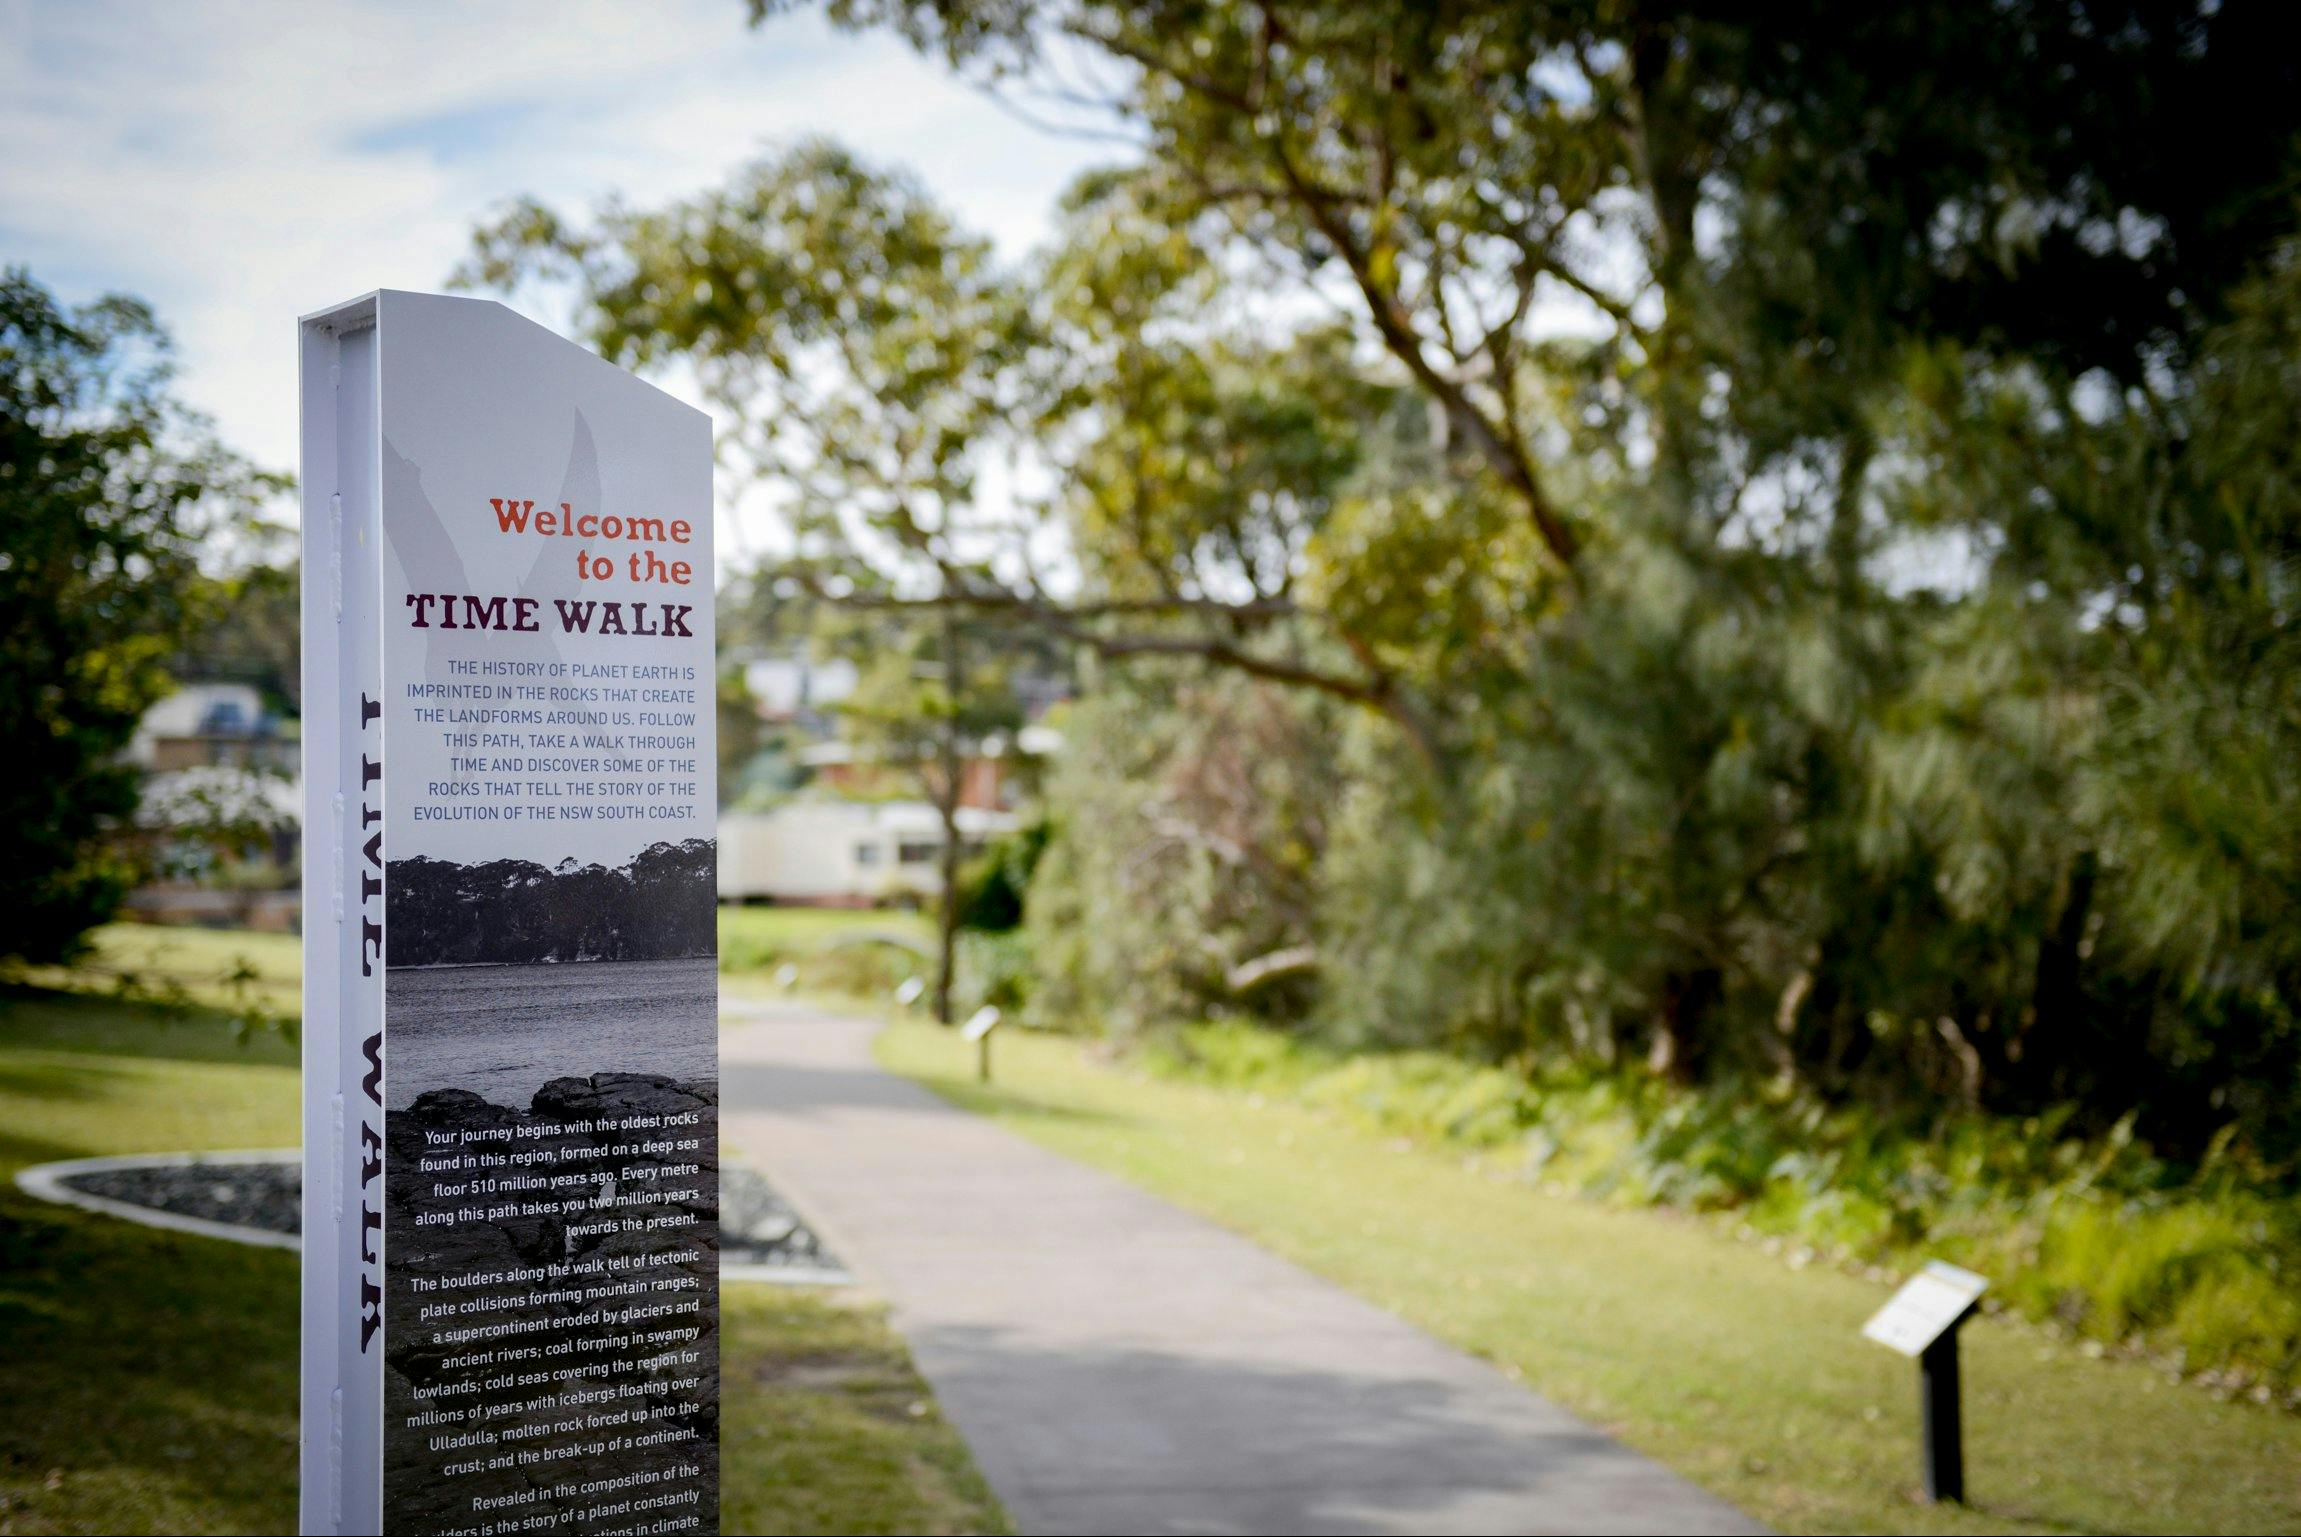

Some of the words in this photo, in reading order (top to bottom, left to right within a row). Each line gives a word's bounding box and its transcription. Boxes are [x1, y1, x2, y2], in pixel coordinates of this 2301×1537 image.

[489, 498, 692, 544] Welcome
[577, 549, 614, 581] to
[628, 549, 692, 585] the
[405, 594, 540, 632] TIME
[554, 599, 693, 637] WALK
[447, 659, 478, 675] THE
[482, 660, 545, 677] HISTORY
[548, 662, 567, 677] OF
[572, 663, 628, 678] PLANET
[632, 665, 678, 679] EARTH
[682, 666, 695, 680] IS
[407, 683, 492, 699] IMPRINTED
[497, 685, 512, 699] IN
[516, 685, 545, 700] THE
[550, 686, 598, 701] ROCKS
[602, 688, 638, 702] THAT
[642, 689, 695, 703] CREATE
[413, 708, 445, 723] THE
[449, 708, 543, 724] LANDFORMS
[546, 710, 608, 725] AROUND
[612, 712, 635, 725] US.
[639, 712, 695, 726] FOLLOW
[442, 732, 478, 747] THIS
[482, 733, 524, 750] PATH,
[528, 734, 566, 748] TAKE
[569, 735, 579, 748] A
[582, 735, 624, 749] WALK
[627, 735, 695, 749] THROUGH
[450, 757, 487, 772] TIME
[490, 757, 523, 772] AND
[527, 758, 599, 772] DISCOVER
[603, 758, 643, 772] SOME
[647, 759, 665, 772] OF
[668, 759, 696, 772] THE
[428, 781, 480, 796] ROCKS
[483, 781, 522, 796] THAT
[525, 782, 562, 796] TELL
[565, 782, 594, 796] THE
[598, 782, 643, 796] STORY
[647, 782, 665, 796] OF
[668, 782, 696, 796] THE
[413, 806, 499, 821] EVOLUTION
[503, 806, 523, 820] OF
[526, 805, 555, 820] THE
[560, 805, 594, 820] NSW
[597, 805, 644, 819] SOUTH
[648, 805, 696, 819] COAST.
[425, 1130, 457, 1145] Your
[461, 1128, 513, 1145] journey
[516, 1122, 561, 1140] begins
[563, 1119, 592, 1134] with
[596, 1117, 617, 1131] the
[620, 1114, 661, 1129] oldest
[662, 1111, 699, 1128] rocks
[419, 1155, 460, 1172] found
[464, 1154, 476, 1168] in
[480, 1152, 506, 1167] this
[509, 1148, 557, 1166] region,
[560, 1143, 608, 1160] formed
[611, 1144, 628, 1156] on
[631, 1143, 639, 1154] a
[642, 1139, 674, 1155] deep
[676, 1138, 699, 1150] sea
[433, 1183, 467, 1197] floor
[471, 1178, 496, 1194] 510
[499, 1175, 547, 1191] million
[550, 1173, 587, 1190] years
[590, 1171, 618, 1187] ago.
[621, 1166, 658, 1181] Every
[660, 1163, 699, 1177] metre
[415, 1211, 454, 1226] along
[457, 1206, 485, 1222] this
[488, 1203, 518, 1220] path
[522, 1202, 559, 1215] takes
[562, 1199, 585, 1213] you
[588, 1197, 610, 1210] two
[615, 1190, 662, 1207] million
[663, 1188, 700, 1205] years
[565, 1219, 619, 1237] towards
[621, 1217, 643, 1231] the
[646, 1212, 699, 1232] present.
[410, 1277, 437, 1292] The
[441, 1271, 503, 1289] boulders
[506, 1267, 545, 1282] along
[547, 1259, 570, 1277] the
[572, 1258, 604, 1274] walk
[607, 1255, 630, 1271] tell
[633, 1253, 646, 1268] of
[648, 1248, 699, 1266] tectonic
[420, 1302, 456, 1322] plate
[460, 1295, 526, 1313] collisions
[528, 1288, 582, 1305] forming
[586, 1279, 647, 1299] mountain
[651, 1276, 699, 1292] ranges;
[432, 1332, 443, 1344] a
[445, 1317, 549, 1343] supercontinent
[552, 1309, 599, 1329] eroded
[602, 1309, 618, 1325] by
[620, 1303, 673, 1324] glaciers
[675, 1298, 699, 1314] and
[441, 1350, 493, 1369] ancient
[497, 1347, 541, 1362] rivers;
[545, 1337, 573, 1356] coal
[576, 1334, 628, 1353] forming
[632, 1331, 644, 1344] in
[647, 1326, 700, 1346] swampy
[413, 1379, 481, 1400] lowlands;
[485, 1373, 513, 1390] cold
[517, 1371, 549, 1386] seas
[552, 1362, 609, 1381] covering
[612, 1359, 634, 1373] the
[637, 1350, 678, 1374] region
[680, 1349, 700, 1364] for
[407, 1410, 464, 1428] millions
[468, 1403, 482, 1419] of
[484, 1401, 523, 1420] years
[526, 1394, 555, 1411] with
[559, 1388, 616, 1406] icebergs
[618, 1380, 668, 1398] floating
[671, 1377, 700, 1390] over
[429, 1430, 498, 1451] Ulladulla;
[502, 1424, 550, 1441] molten
[554, 1416, 583, 1433] rock
[586, 1409, 628, 1428] forced
[631, 1409, 648, 1424] up
[651, 1404, 676, 1419] into
[678, 1401, 699, 1415] the
[443, 1458, 485, 1476] crust;
[488, 1450, 514, 1469] and
[517, 1450, 540, 1465] the
[543, 1442, 605, 1461] break-up
[608, 1436, 621, 1451] of
[624, 1438, 632, 1449] a
[635, 1426, 699, 1447] continent.
[472, 1488, 535, 1511] Revealed
[538, 1486, 551, 1500] in
[555, 1483, 577, 1497] the
[580, 1470, 660, 1494] composition
[663, 1465, 676, 1480] of
[678, 1463, 700, 1478] the
[481, 1522, 493, 1536] is
[496, 1519, 519, 1534] the
[522, 1514, 558, 1530] story
[560, 1508, 574, 1523] of
[577, 1511, 585, 1521] a
[589, 1500, 631, 1522] planet
[633, 1489, 700, 1511] constantly
[637, 1524, 648, 1536] in
[652, 1516, 700, 1533] climate
